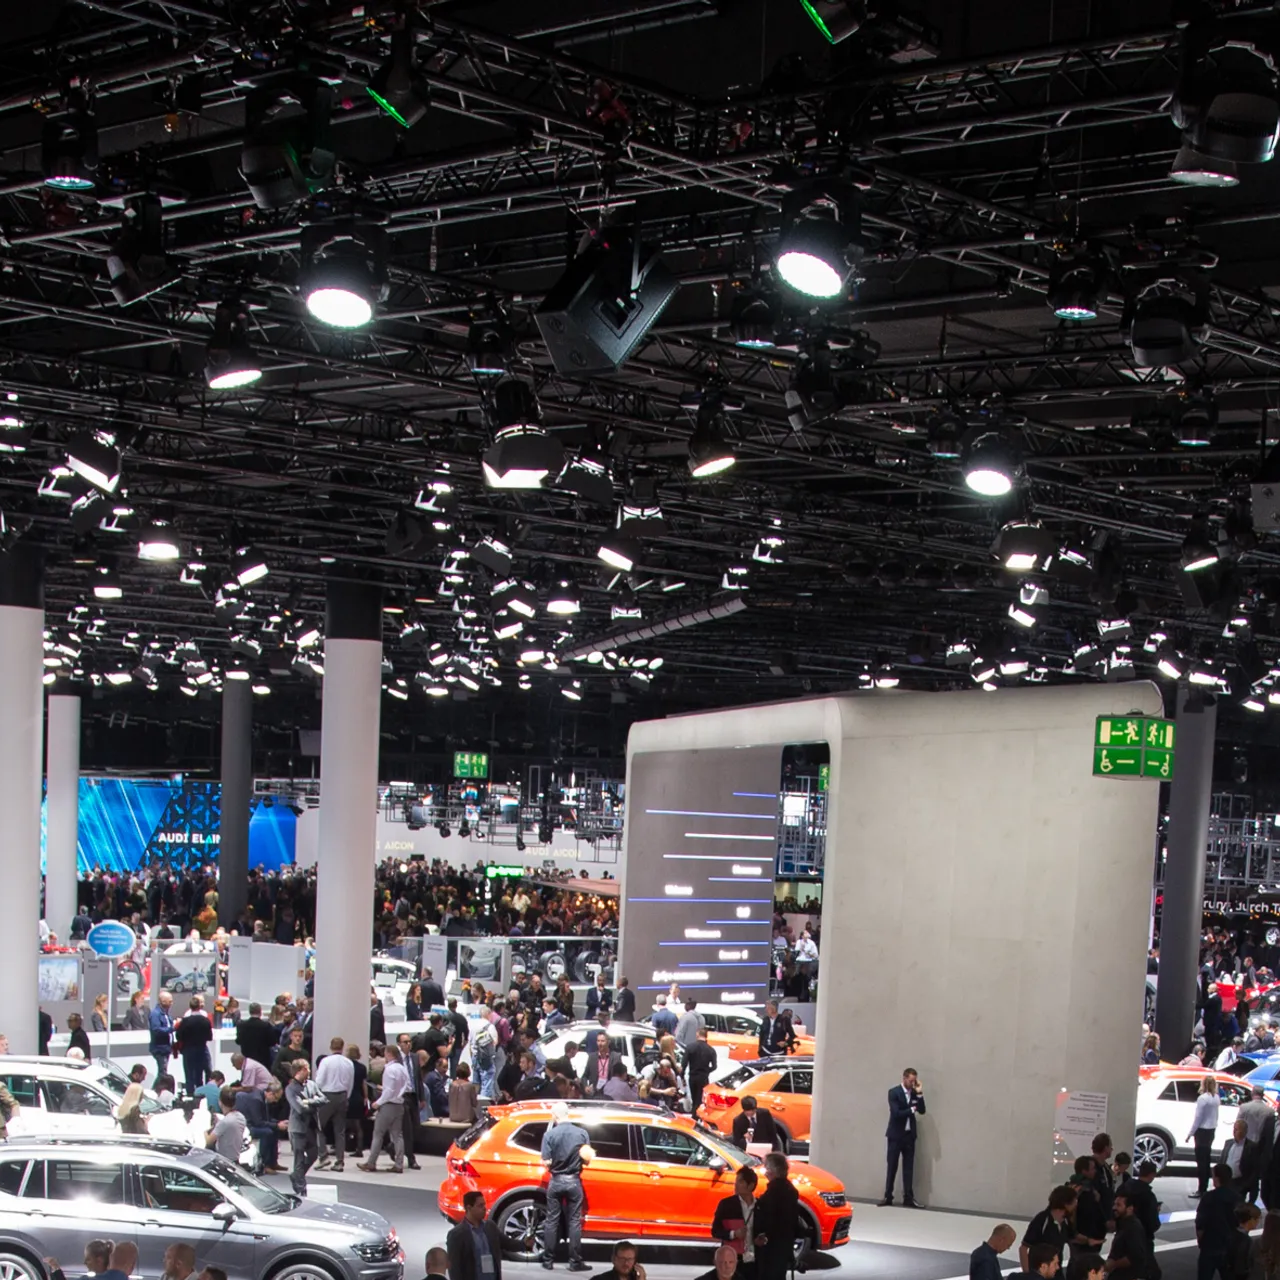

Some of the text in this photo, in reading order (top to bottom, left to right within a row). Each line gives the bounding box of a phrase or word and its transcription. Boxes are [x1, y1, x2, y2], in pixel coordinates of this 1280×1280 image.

[158, 832, 189, 844] AUDI
[384, 841, 415, 850] AICON
[524, 847, 550, 857] AUDI
